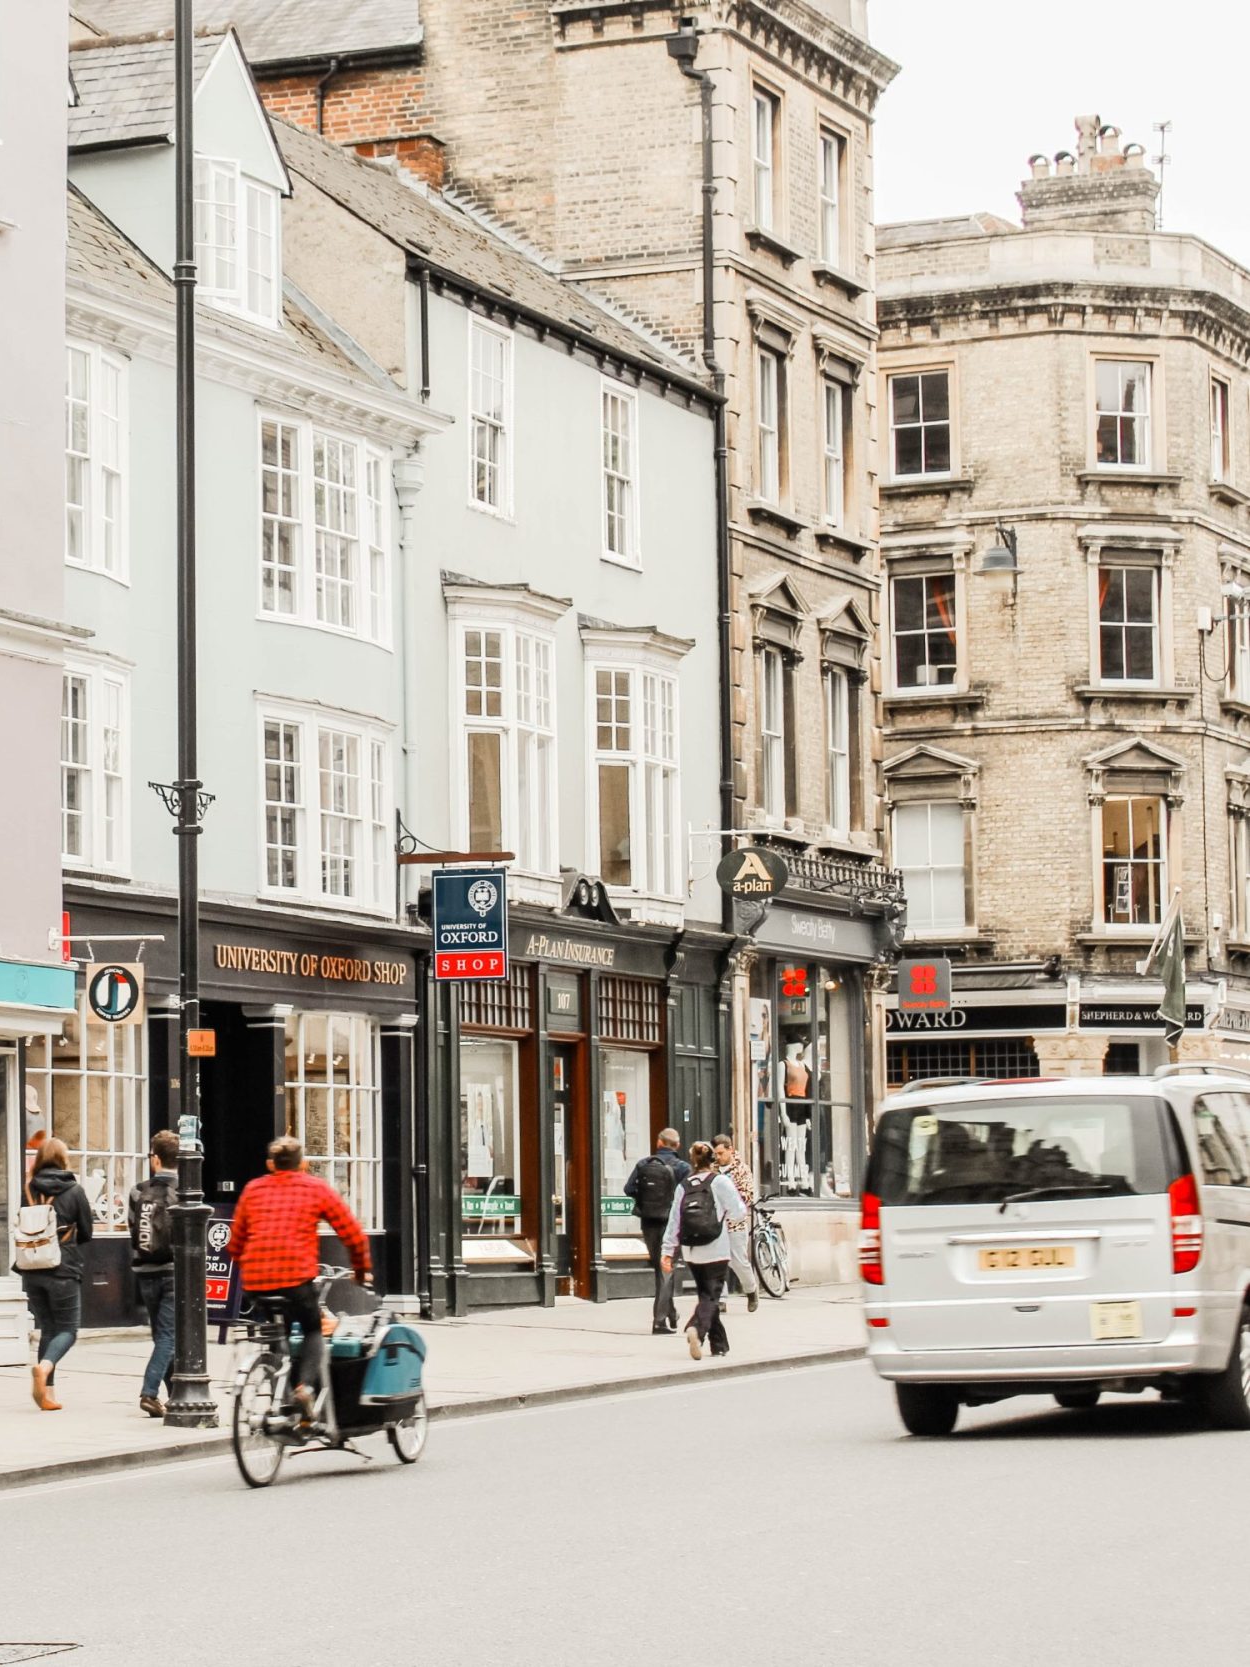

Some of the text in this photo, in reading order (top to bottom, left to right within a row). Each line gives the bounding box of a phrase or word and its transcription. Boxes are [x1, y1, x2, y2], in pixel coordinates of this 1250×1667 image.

[733, 879, 771, 894] a-plan
[441, 922, 487, 931] UNIVERSITY OF
[791, 914, 836, 945] Sweaty Betty
[440, 931, 498, 944] OXFORD
[216, 944, 407, 985] UNIVERSITY OF OXFORD SHOP
[441, 959, 499, 971] SHOP
[557, 993, 570, 1009] 107
[1081, 1010, 1133, 1021] SHEPHERD
[1134, 1011, 1142, 1021] &
[139, 1203, 153, 1251] ADIDAS
